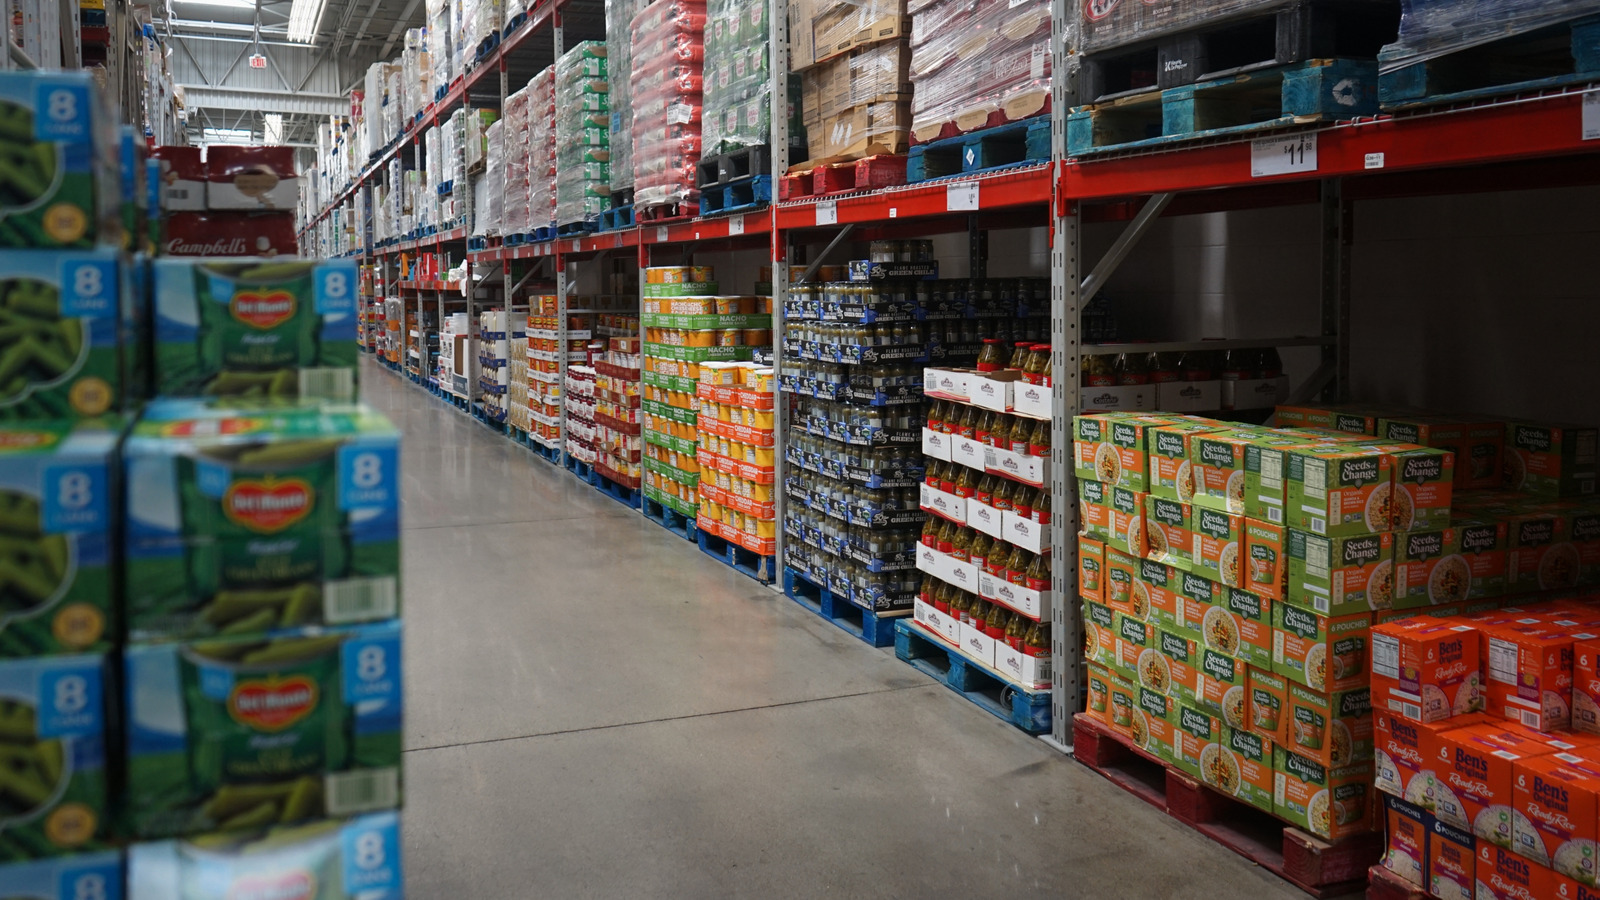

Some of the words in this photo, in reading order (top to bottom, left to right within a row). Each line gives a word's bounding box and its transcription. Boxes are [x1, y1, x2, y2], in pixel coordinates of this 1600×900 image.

[49, 90, 77, 120] 8
[166, 238, 246, 255] Campbell's
[870, 266, 887, 279] 505
[75, 266, 102, 296] 8
[324, 272, 346, 297] 8
[862, 349, 879, 362] 505
[1390, 424, 1412, 434] Seeds
[1520, 428, 1543, 439] Seeds
[872, 430, 889, 443] 505
[1160, 434, 1178, 444] Seeds
[1158, 441, 1182, 453] Change
[1204, 443, 1226, 454] Seeds
[1517, 438, 1549, 450] Change
[1203, 451, 1231, 463] Change
[352, 452, 381, 487] 8
[1344, 461, 1370, 471] Seeds
[1409, 460, 1434, 468] Seeds
[1342, 469, 1376, 481] Change
[1405, 467, 1439, 477] Change
[58, 473, 91, 508] 8
[1157, 501, 1176, 512] Seeds
[873, 513, 889, 526] 505
[1157, 510, 1182, 522] Change
[1204, 512, 1224, 524] Seeds
[1202, 520, 1228, 534] Change
[1253, 528, 1278, 540] POUCHES
[1412, 536, 1435, 544] Seeds
[1466, 530, 1489, 538] Seeds
[1347, 540, 1372, 551] Seeds
[1409, 544, 1440, 555] Change
[1464, 538, 1494, 548] Change
[1345, 549, 1378, 560] Change
[1144, 562, 1161, 572] Seeds
[1143, 569, 1166, 582] Change
[1186, 575, 1206, 588] Seeds
[1184, 583, 1210, 598] Change
[876, 595, 891, 608] 505
[1232, 591, 1253, 605] Seeds
[1231, 598, 1259, 615] Change
[1287, 608, 1310, 622] Seeds
[1123, 619, 1141, 630] Seeds
[1286, 616, 1315, 634] Change
[1337, 620, 1367, 630] POUCHES
[1122, 627, 1144, 641] Change
[1164, 634, 1182, 646] Seeds
[1163, 643, 1187, 658] Change
[1439, 639, 1462, 654] Ben's
[1207, 652, 1228, 667] Seeds
[1427, 648, 1433, 659] 6
[1548, 653, 1554, 665] 6
[1580, 654, 1588, 666] 6
[358, 645, 385, 680] 8
[1205, 661, 1232, 677] Change
[1256, 672, 1283, 689] POUCHES
[56, 674, 87, 710] 8
[1142, 690, 1161, 704] Seeds
[1298, 689, 1327, 706] POUCHES
[1141, 700, 1165, 714] Change
[1184, 710, 1205, 724] Seeds
[1379, 717, 1385, 727] 6
[1182, 718, 1209, 734] Change
[1390, 717, 1417, 739] Ben's
[1234, 730, 1255, 744] Seeds
[1391, 731, 1418, 748] Original
[1233, 737, 1260, 756] Change
[1441, 747, 1447, 757] 6
[1456, 747, 1488, 772] Ben's
[1288, 759, 1322, 780] Change
[1455, 762, 1488, 780] Original
[1518, 775, 1525, 786] 6
[1534, 776, 1568, 802] Ben's
[1533, 791, 1568, 813] Original
[1391, 799, 1396, 808] 6
[1397, 804, 1421, 819] POUCHES
[1435, 821, 1441, 832] 6
[1442, 827, 1470, 844] POUCHES
[356, 834, 383, 869] 8
[1482, 848, 1488, 858] 6
[1496, 848, 1529, 876] Ben's
[1496, 865, 1529, 886] Original
[76, 874, 106, 900] 8
[1560, 883, 1567, 896] 6
